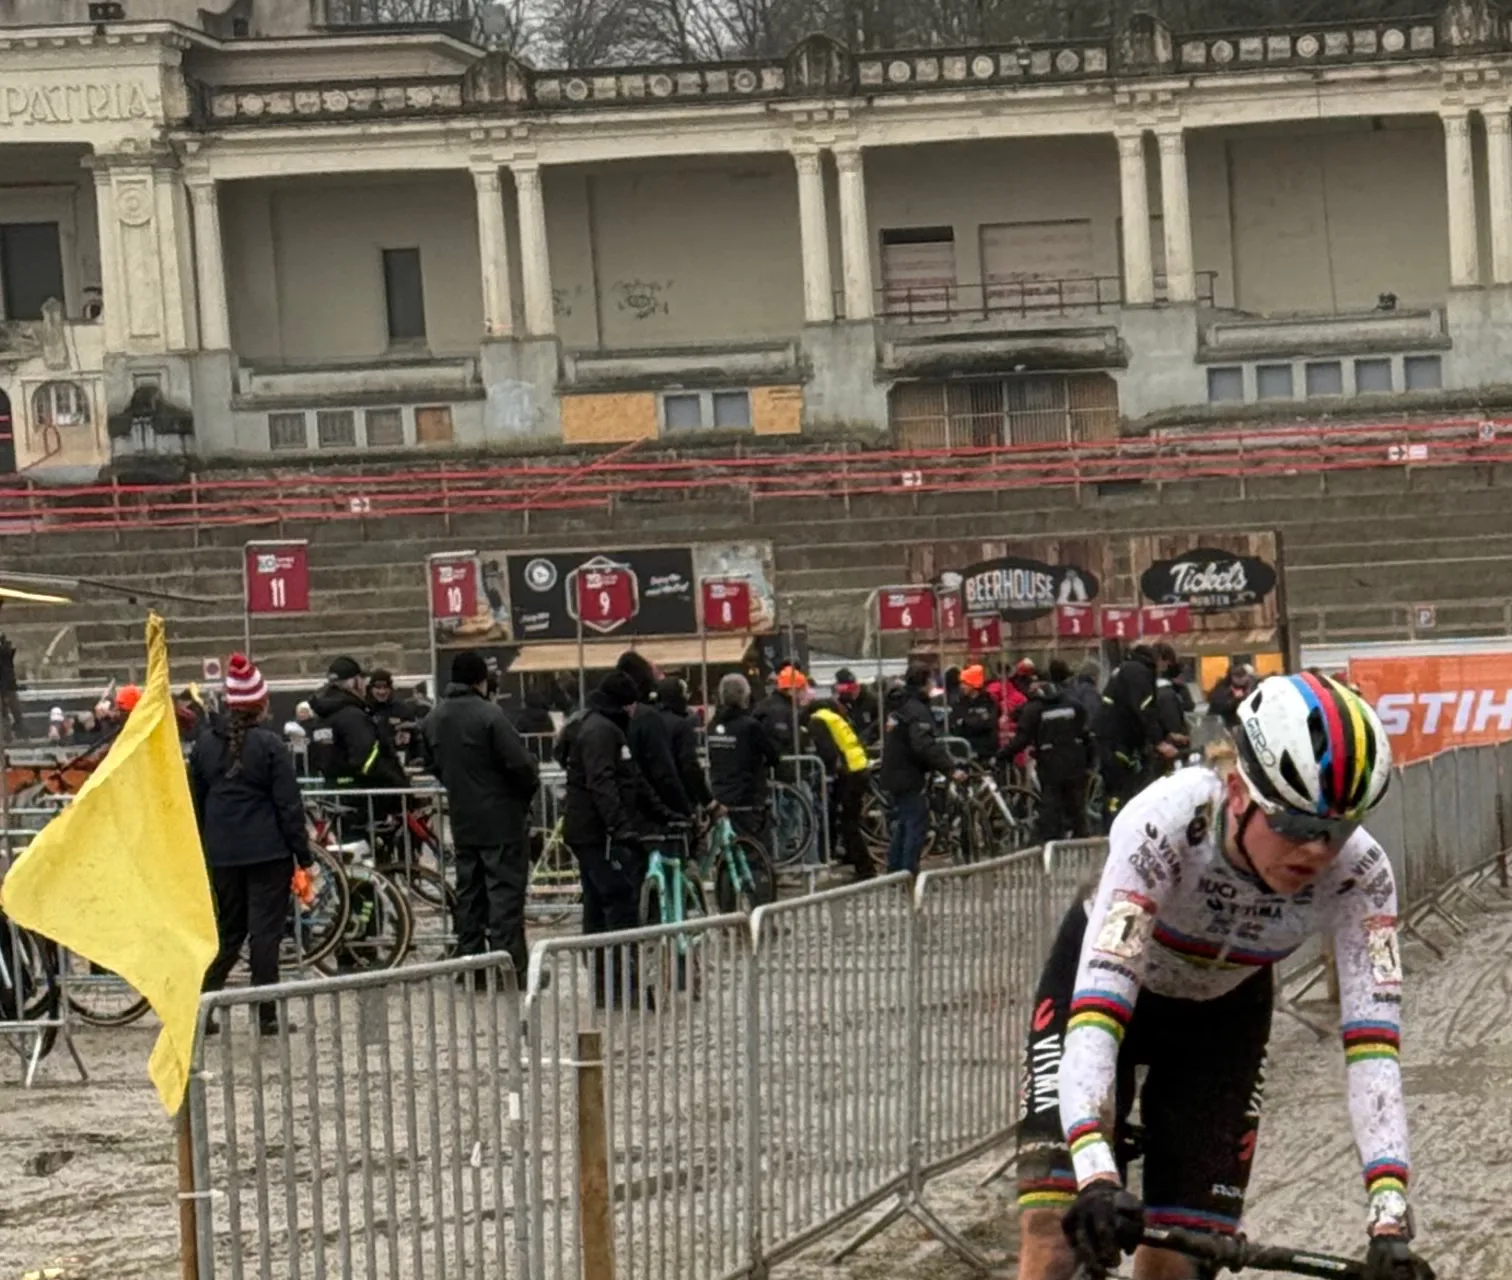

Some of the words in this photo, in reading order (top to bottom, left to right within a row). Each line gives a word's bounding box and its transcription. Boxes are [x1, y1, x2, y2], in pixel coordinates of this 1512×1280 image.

[0, 82, 156, 126] PATRIA
[270, 578, 286, 608] 11
[965, 568, 1054, 602] BEERHOUSE
[1169, 561, 1248, 593] Tickets
[447, 586, 462, 613] 10
[599, 591, 611, 616] 9
[901, 607, 912, 627] 6
[1245, 716, 1277, 768] GIRO
[1032, 1033, 1062, 1114] VISMA
